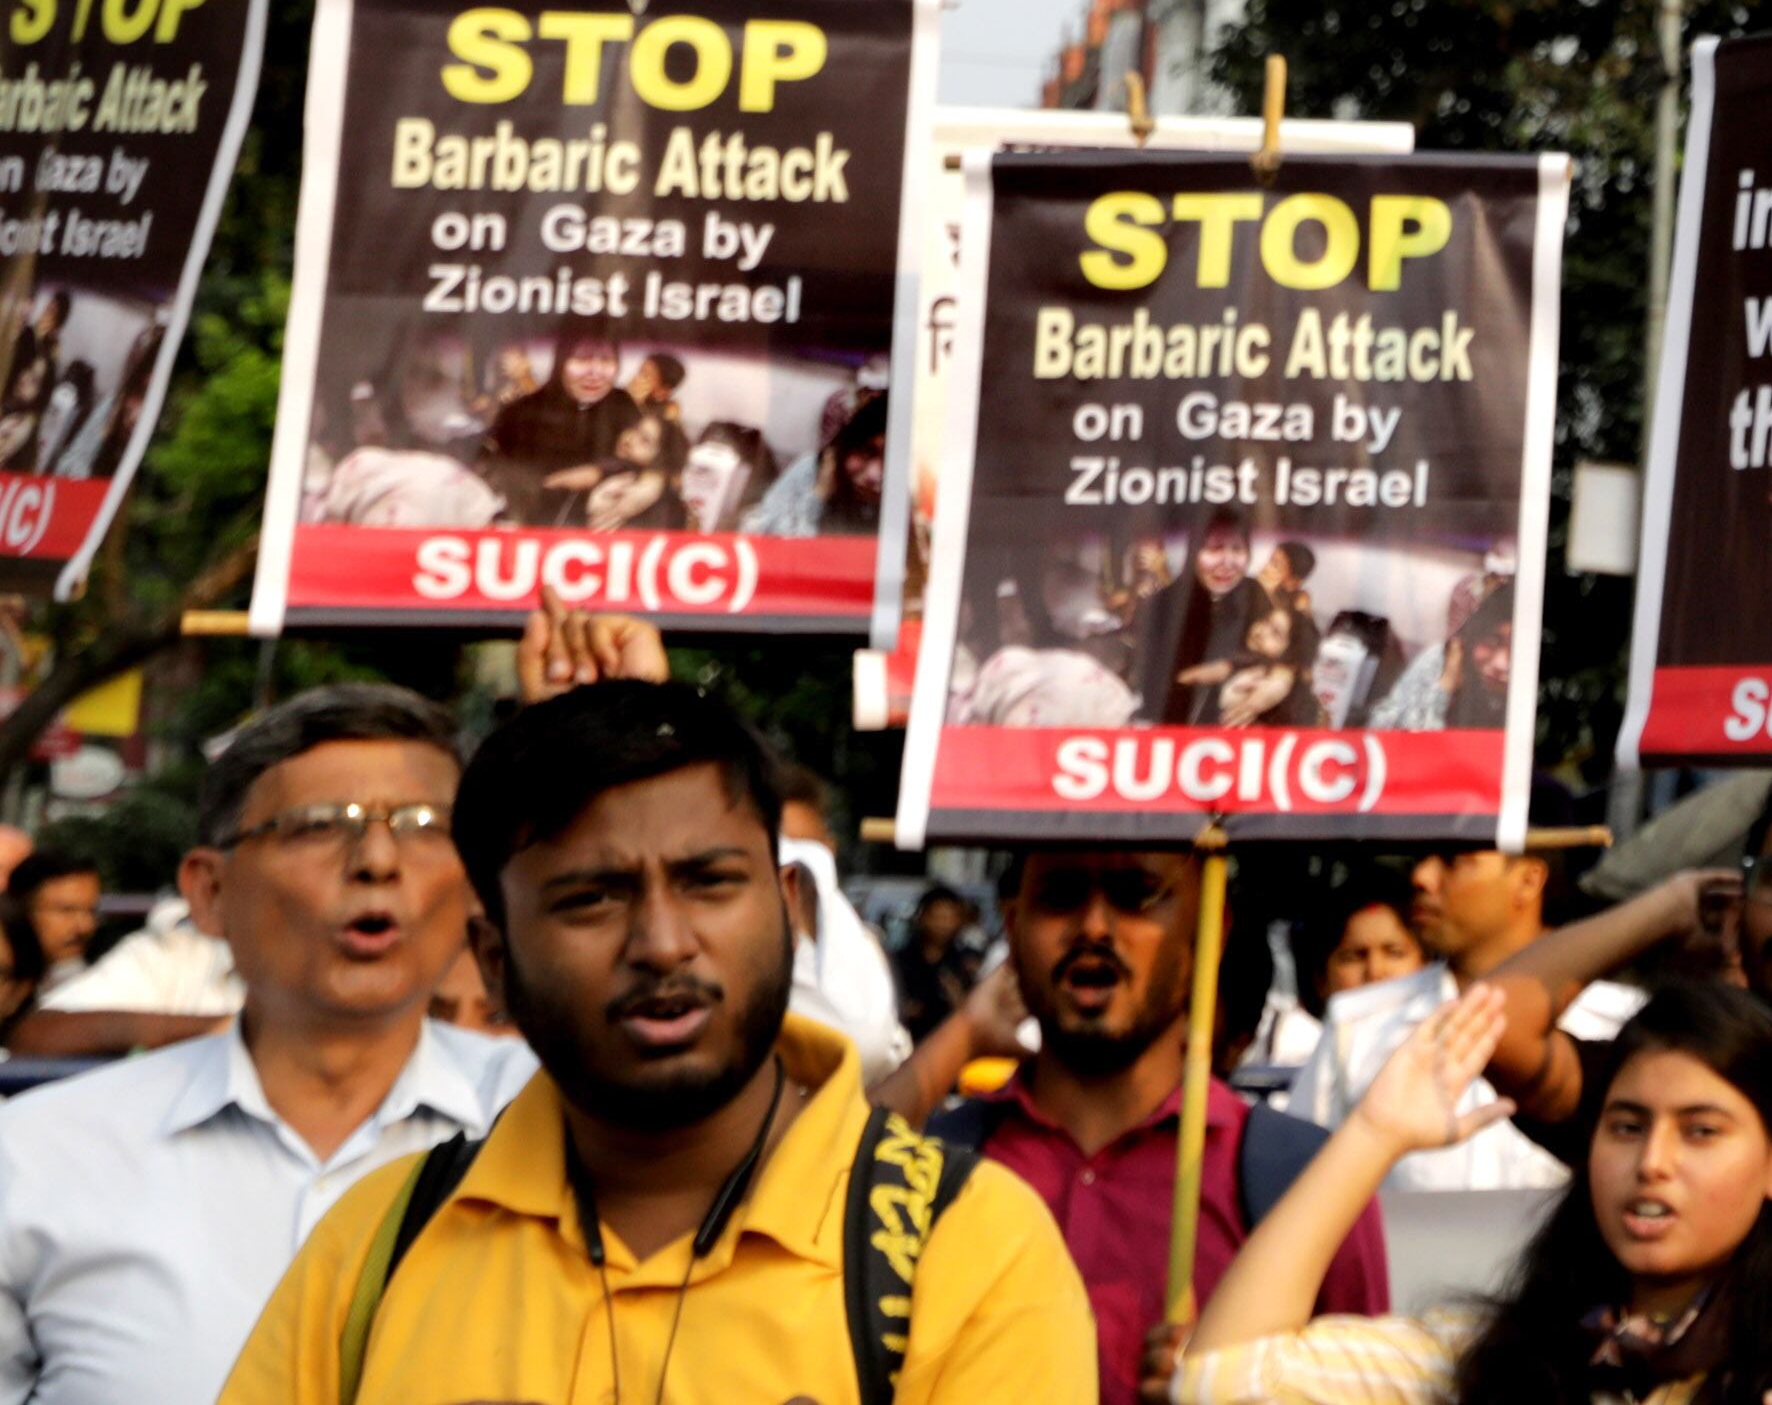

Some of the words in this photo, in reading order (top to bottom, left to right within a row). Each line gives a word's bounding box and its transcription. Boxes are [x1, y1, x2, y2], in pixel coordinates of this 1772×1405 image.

[440, 6, 828, 112] STOP
[93, 61, 208, 134] Attack
[106, 146, 149, 206] by
[392, 117, 642, 194] Barbaric
[655, 126, 851, 202] Attack
[61, 207, 154, 259] Israel
[431, 211, 507, 252] on
[541, 203, 686, 257] Gaza
[703, 210, 775, 271] by
[1079, 191, 1452, 291] STOP
[422, 263, 630, 318] Zionist
[643, 270, 803, 323] Israel
[1034, 306, 1270, 379] Barbaric
[1285, 307, 1476, 382] Attack
[1072, 402, 1143, 442] on
[1176, 391, 1314, 442] Gaza
[1332, 395, 1402, 454] by
[1065, 455, 1259, 506] Zionist
[1274, 460, 1430, 508] Israel
[413, 535, 759, 612] SUCI(C)
[1052, 735, 1387, 812] SUCI(C)
